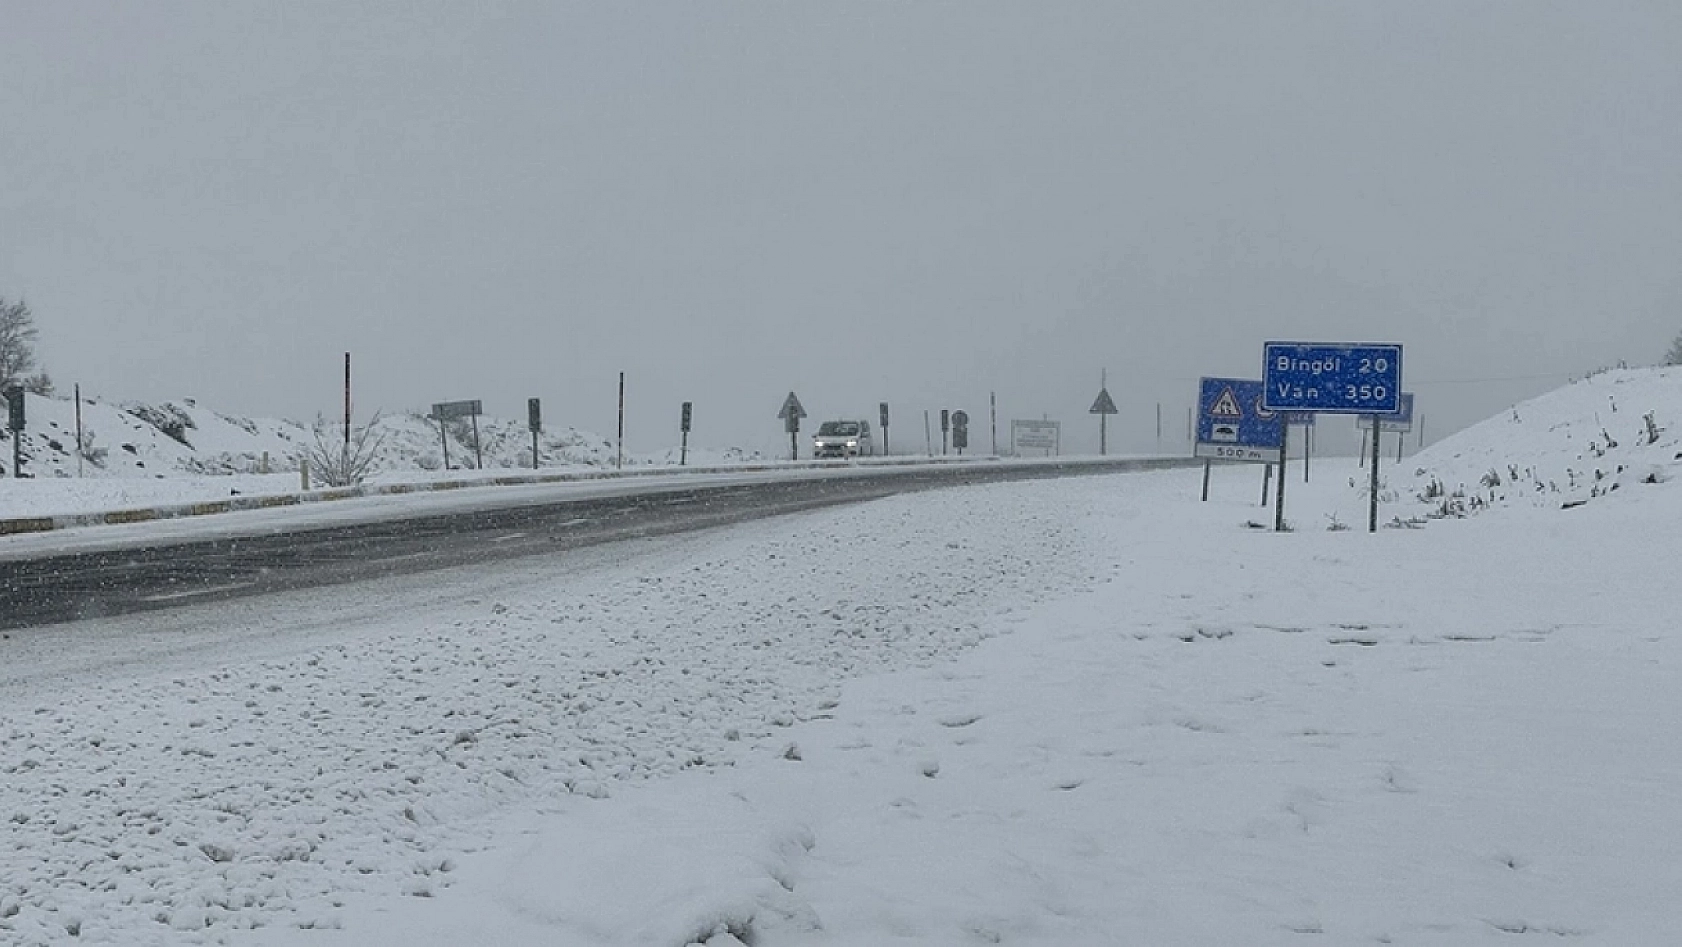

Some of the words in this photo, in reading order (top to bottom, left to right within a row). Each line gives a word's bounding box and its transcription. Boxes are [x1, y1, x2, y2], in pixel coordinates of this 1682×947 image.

[1277, 356, 1340, 374] Bingöl
[1359, 358, 1387, 373] 20
[1278, 382, 1318, 399] Van
[1346, 384, 1386, 400] 350
